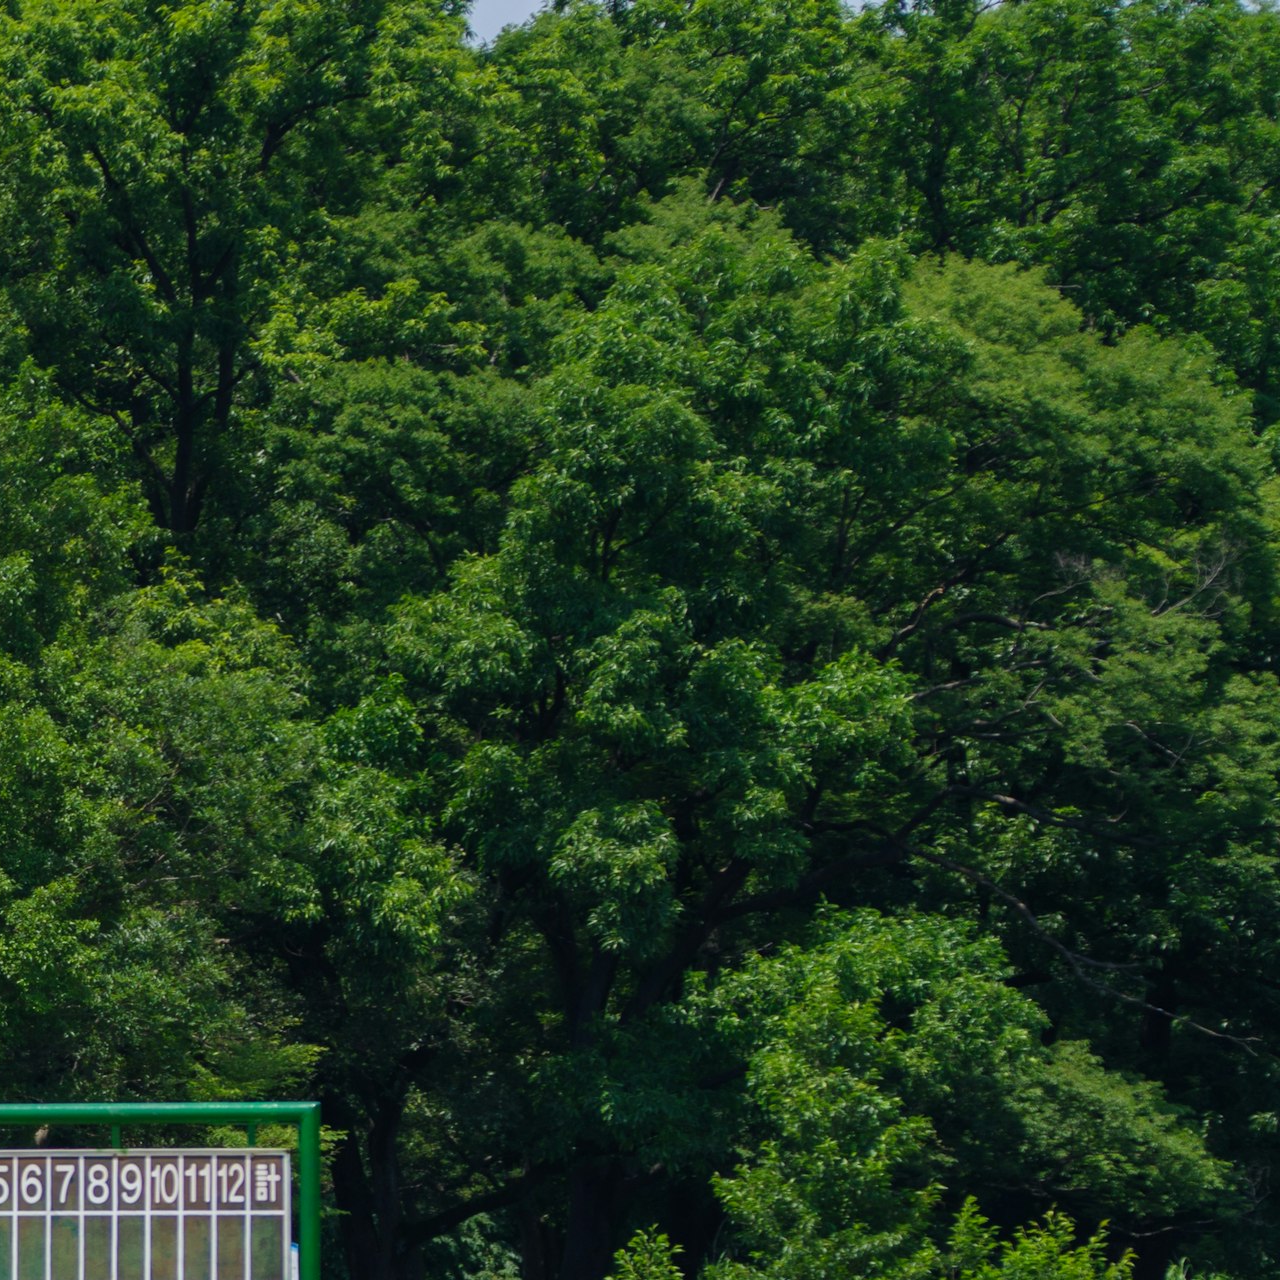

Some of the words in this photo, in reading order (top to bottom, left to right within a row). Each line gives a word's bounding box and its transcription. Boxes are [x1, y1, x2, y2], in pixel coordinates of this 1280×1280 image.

[21, 1164, 42, 1204] 6
[55, 1164, 75, 1203] 7
[87, 1164, 109, 1204] 8
[120, 1163, 142, 1203] 9
[151, 1163, 179, 1203] 10
[185, 1163, 210, 1203] 11
[217, 1163, 245, 1203] 12
[254, 1163, 281, 1202] 計
